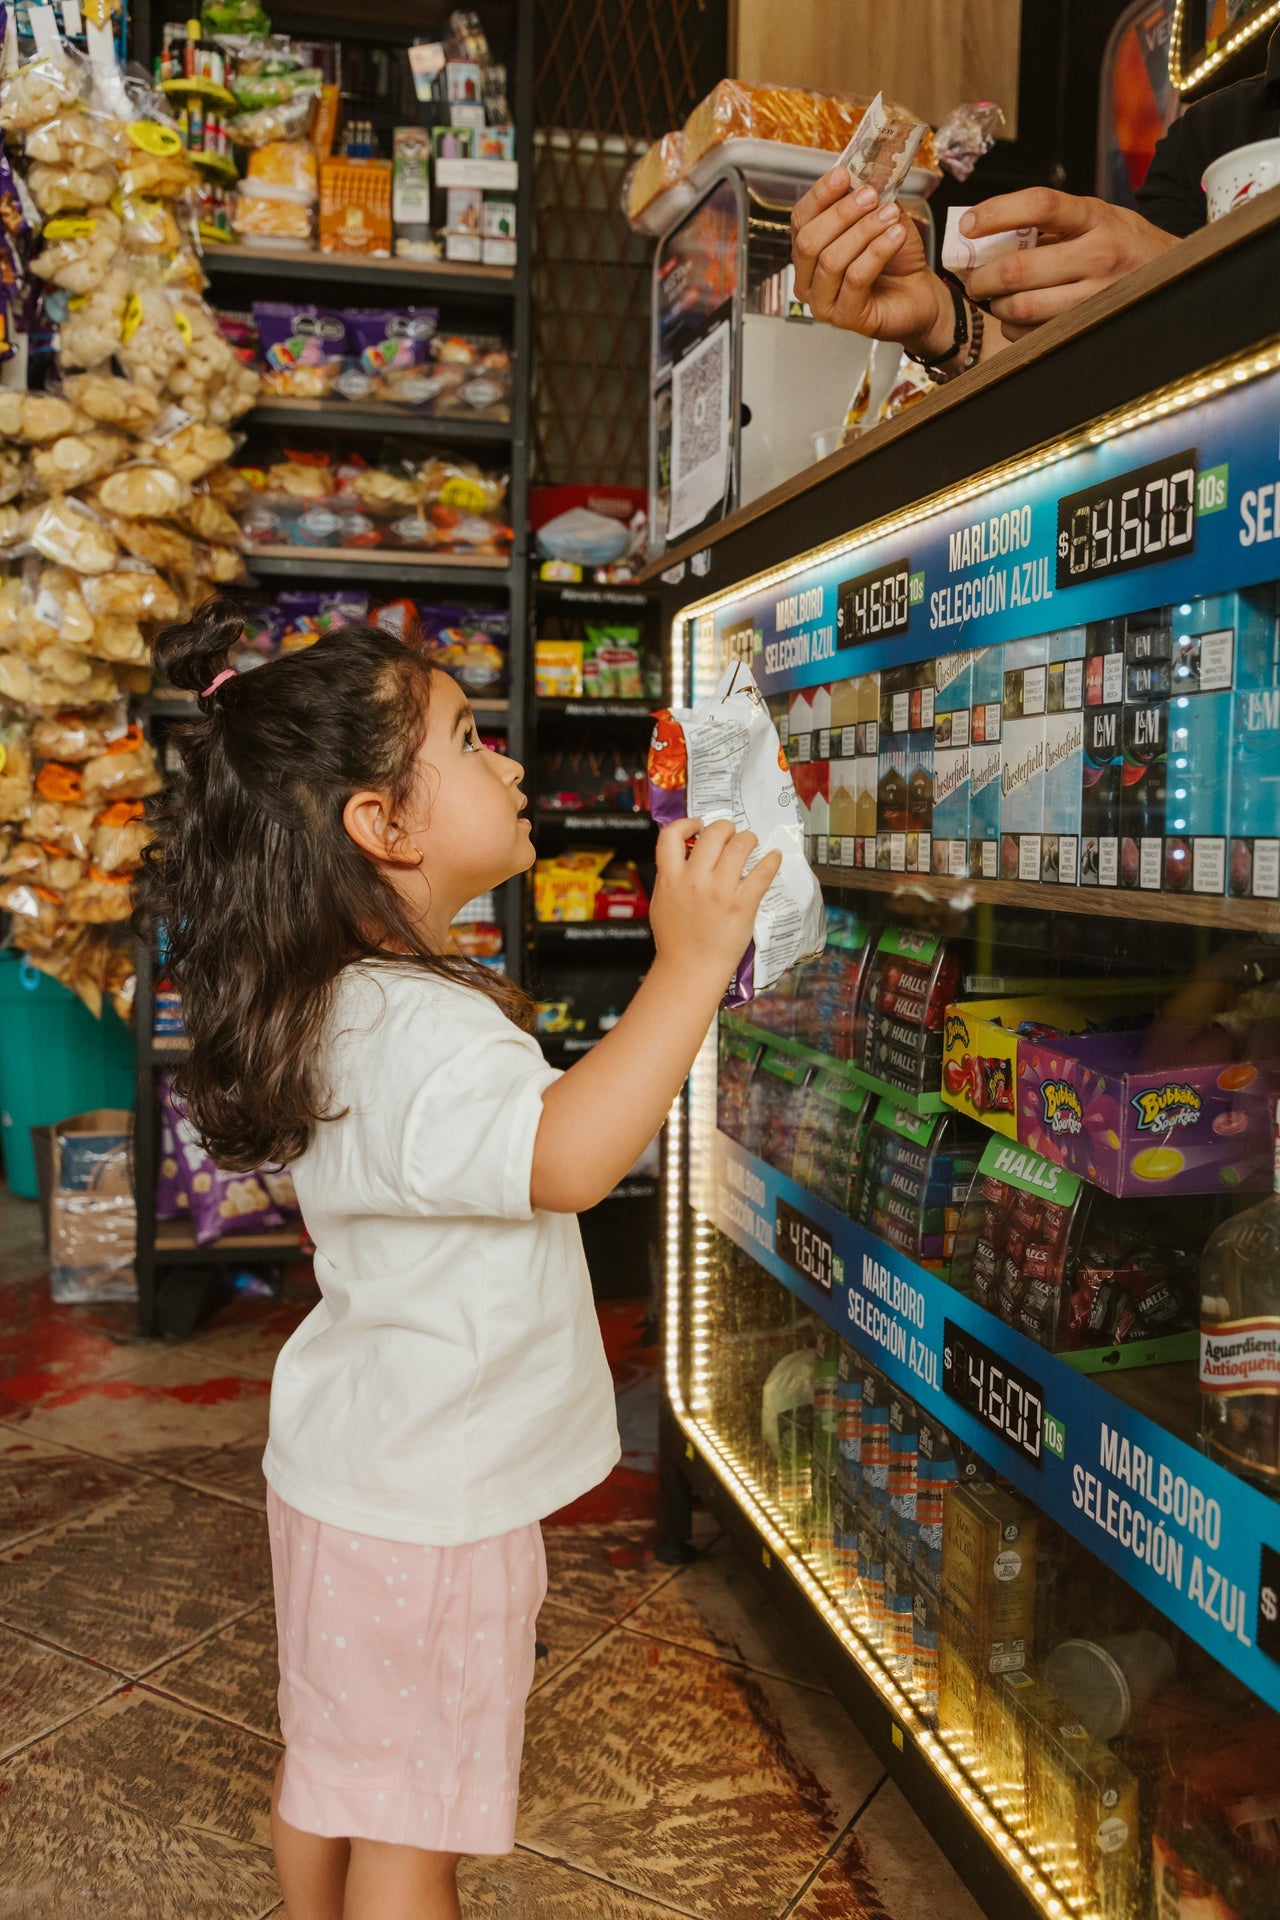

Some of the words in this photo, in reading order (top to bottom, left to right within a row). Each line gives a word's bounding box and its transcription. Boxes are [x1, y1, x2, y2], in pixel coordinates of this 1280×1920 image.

[1198, 474, 1225, 510] 10s
[949, 505, 1031, 573] MARLBORO
[1058, 531, 1069, 558] $
[909, 577, 923, 602] 10s
[930, 565, 1006, 630] SELECCIÓN
[1010, 556, 1052, 609] AZUL
[776, 586, 823, 632] MARLBORO
[837, 608, 844, 628] $
[765, 629, 810, 675] SELECCIÓN
[811, 625, 835, 663] AZUL
[1135, 709, 1159, 745] L&M
[1248, 690, 1280, 731] L&M
[1044, 724, 1082, 772] Chesterfield
[1093, 713, 1116, 748] L&M
[933, 751, 969, 805] Chesterfield
[970, 752, 1000, 797] Chesterfield
[1002, 741, 1044, 797] Chesterfield
[898, 972, 928, 996] HALLS
[893, 999, 923, 1022] HALLS
[891, 1024, 919, 1049] HALLS
[889, 1050, 917, 1074] HALLS
[1139, 1087, 1201, 1124] Bubbaloo
[1151, 1107, 1200, 1134] Sparkies
[897, 1147, 926, 1171] HALLS
[994, 1148, 1062, 1192] HALLS
[890, 1172, 919, 1198] HALLS
[887, 1199, 916, 1225] HALLS
[790, 1221, 832, 1289] 4.600
[887, 1225, 915, 1250] HALLS
[862, 1254, 925, 1330] MARLBORO
[1138, 1286, 1171, 1313] HALLS
[848, 1288, 906, 1365] SELECCIÓN
[909, 1335, 940, 1392] AZUL
[944, 1346, 952, 1371] $
[968, 1355, 1042, 1458] 4.600
[1043, 1416, 1063, 1454] 10s
[1100, 1422, 1221, 1551] MARLBORO
[1072, 1463, 1184, 1591] SELECCIÓN
[1188, 1555, 1251, 1648] AZUL
[1260, 1586, 1277, 1621] $
